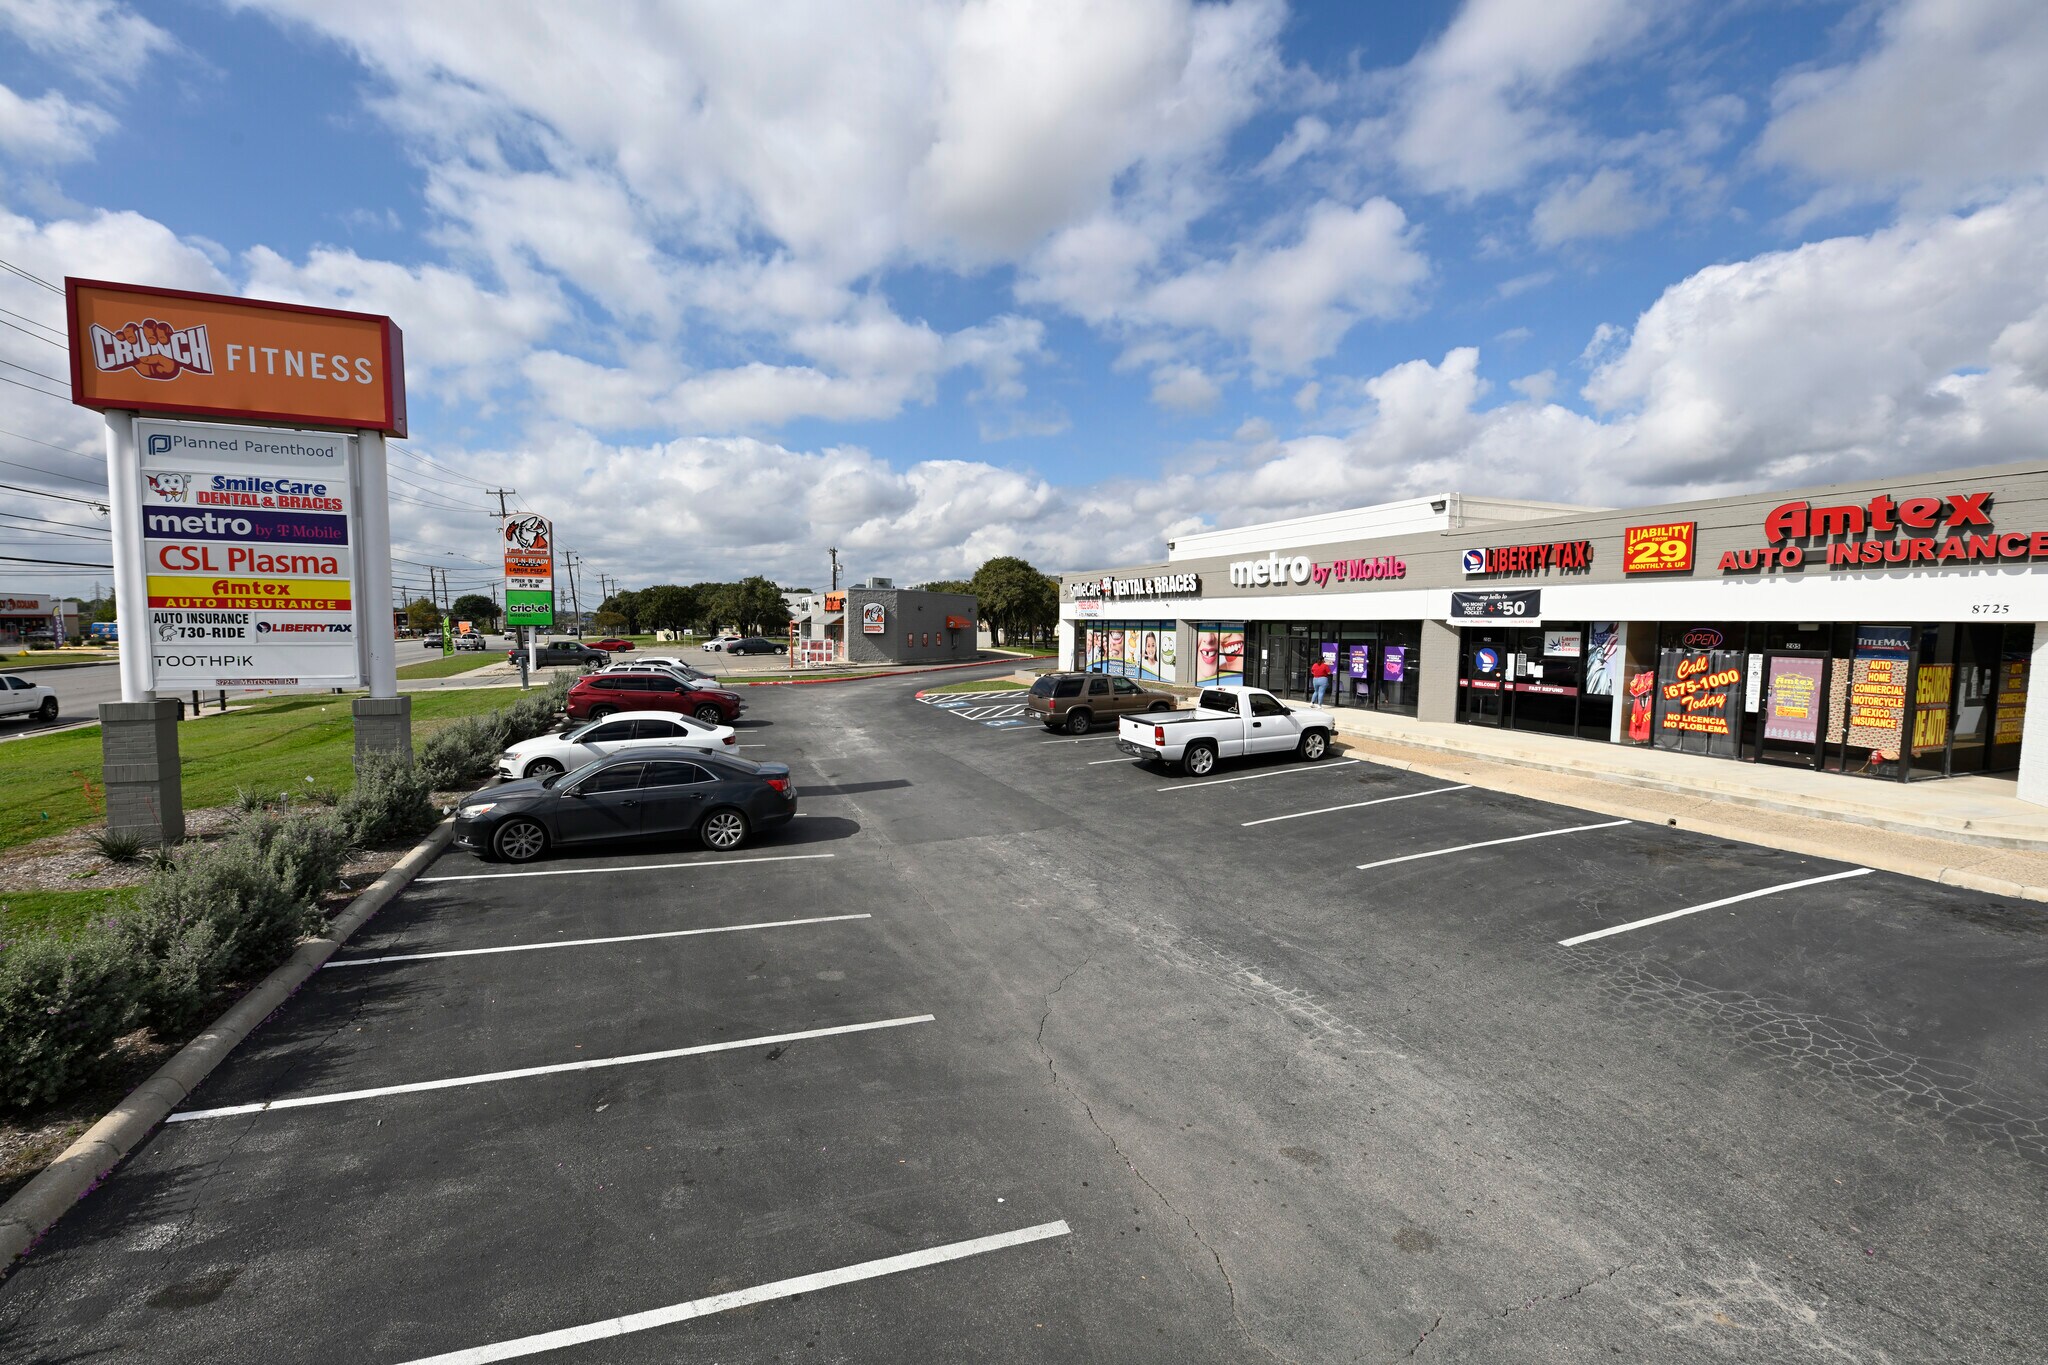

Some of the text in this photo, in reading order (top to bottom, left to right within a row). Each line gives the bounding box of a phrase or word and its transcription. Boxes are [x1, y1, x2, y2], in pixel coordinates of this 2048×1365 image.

[91, 323, 373, 385] CRUNCH FITNESS
[173, 436, 334, 458] Planned Parenthood
[211, 475, 327, 496] SmileCare
[197, 491, 343, 512] DENTAL & BRACES
[149, 512, 252, 535] metro
[255, 524, 272, 539] by
[1764, 492, 1994, 543] Amtex
[1629, 525, 1690, 545] LIABILITY
[1485, 541, 1587, 573] LIBERTY TAX
[1627, 540, 1687, 564] $29
[1717, 531, 2048, 570] AUTO INSURANCE
[159, 545, 338, 575] CSL Plasma
[1230, 551, 1312, 586] metro
[1312, 562, 1331, 588] by
[212, 580, 291, 596] Amtex
[1069, 573, 1197, 598] SmileCare DENTAL & BRACES
[166, 598, 337, 609] AUTO INSURANCE
[510, 603, 549, 613] cricket
[1497, 600, 1526, 616] $50
[1971, 604, 2010, 615] 8725
[154, 612, 249, 625] AUTO INSURANCE
[178, 626, 245, 639] 730-RIDE
[1684, 633, 1720, 645] OPEN
[1857, 637, 1911, 650] TITLEMAX
[1352, 663, 1364, 673] $25
[1677, 656, 1707, 679] Call
[1869, 660, 1892, 670] AUTO
[240, 678, 279, 686] Marbach
[1668, 669, 1739, 698] 675-1000
[1775, 677, 1814, 686] Amtex
[1868, 672, 1891, 683] HOME
[1916, 665, 1952, 704] SEGUROS
[1854, 684, 1904, 695] COMMERCIAL
[1681, 694, 1727, 711] Today
[1852, 696, 1904, 707] MOTORCYCLE
[1682, 715, 1726, 725] LICENCIA
[1860, 707, 1890, 718] MEXICO
[1679, 722, 1729, 734] PLOBLEMA
[1852, 717, 1896, 728] INSURANCE
[1913, 708, 1947, 747] DE AUTO
